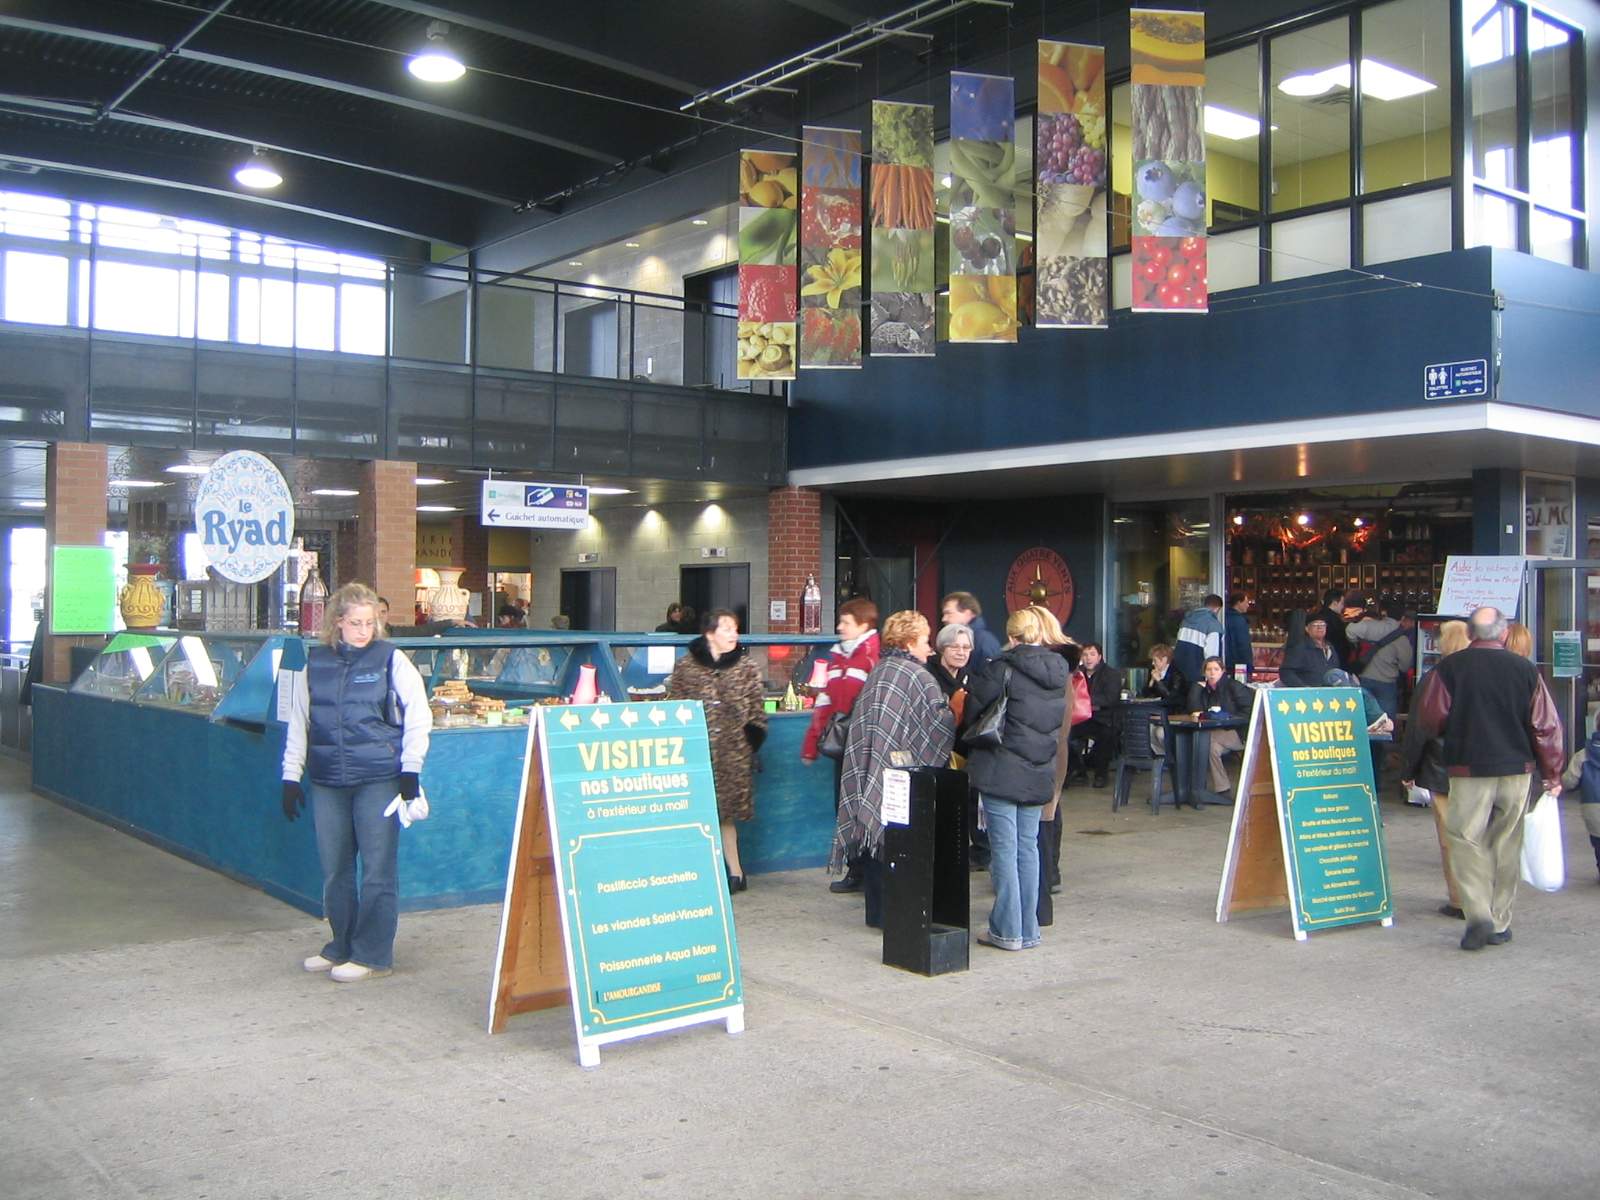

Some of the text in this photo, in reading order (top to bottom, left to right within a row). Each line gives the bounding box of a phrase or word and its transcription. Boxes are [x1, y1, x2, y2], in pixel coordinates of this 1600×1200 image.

[238, 499, 253, 513] le
[505, 511, 585, 527] Guichet automatique
[202, 510, 288, 554] Ryad
[1289, 720, 1354, 744] VISITEZ
[577, 736, 685, 772] VISITEZ
[1292, 745, 1357, 761] nos boutiques
[1333, 767, 1342, 775] du
[580, 773, 689, 796] nos boutiques
[587, 807, 596, 819] à
[598, 803, 647, 818] l'extérieur
[650, 802, 663, 813] du
[597, 871, 698, 894] Pastificcio Sacchetto
[591, 906, 713, 935] Les viandes Saint-Vincent
[600, 944, 717, 973] Poissonnerie Aqua Mare
